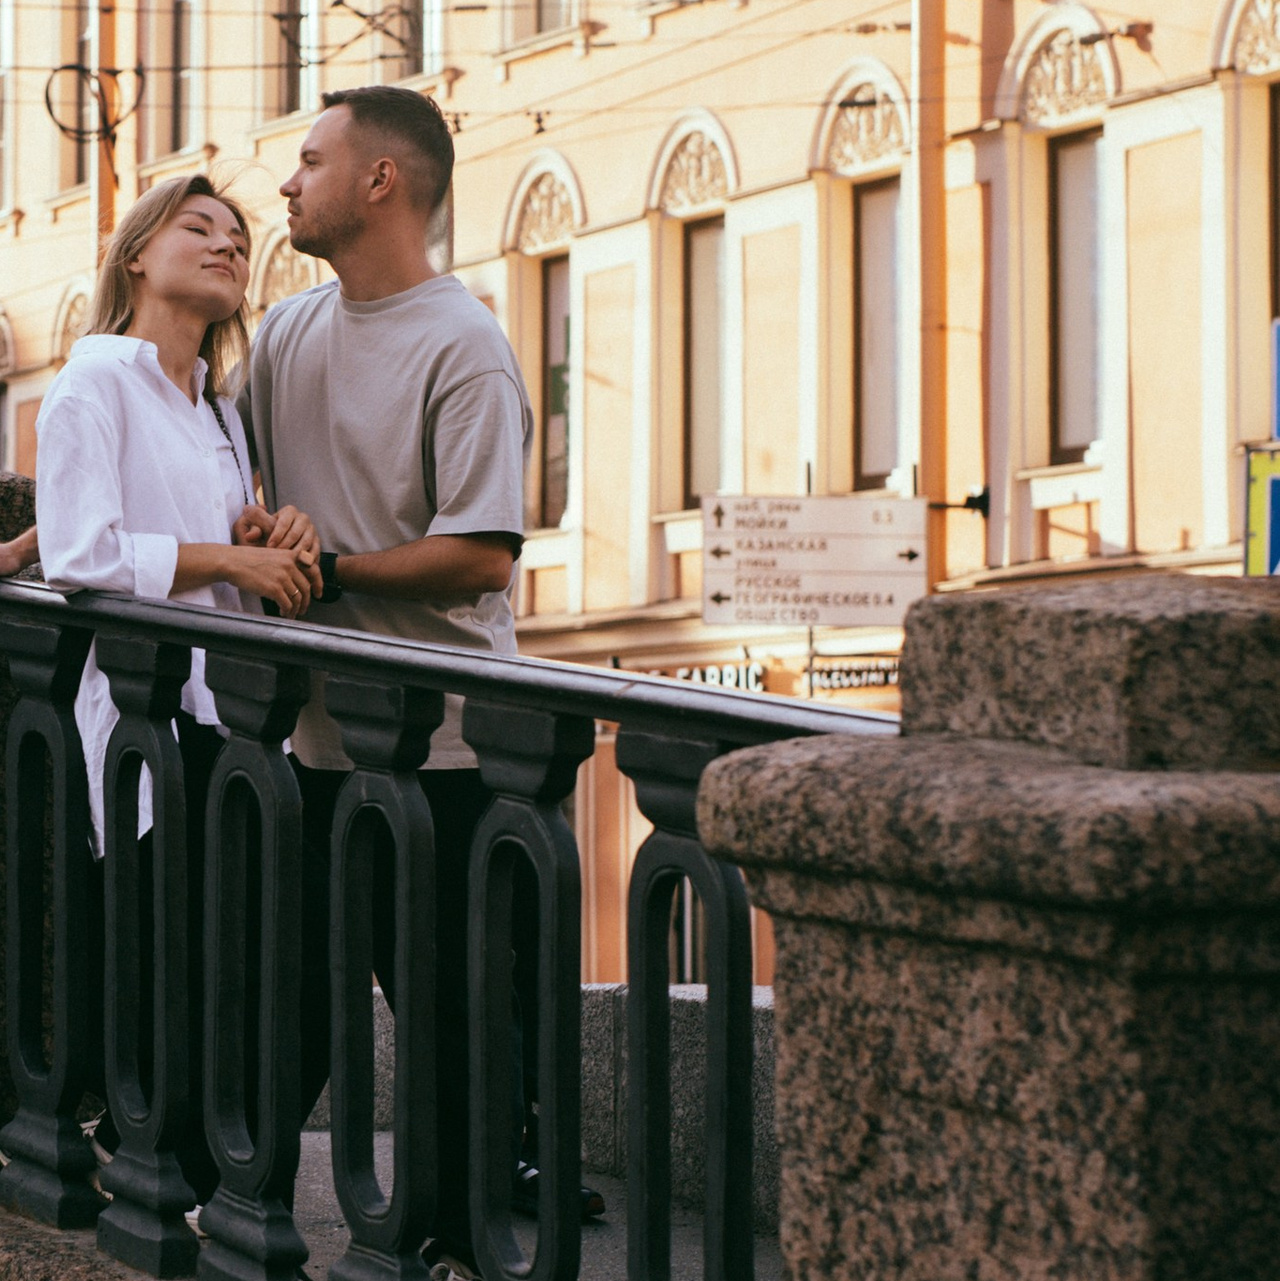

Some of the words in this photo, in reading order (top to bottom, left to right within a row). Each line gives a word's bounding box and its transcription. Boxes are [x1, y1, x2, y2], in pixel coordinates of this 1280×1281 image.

[735, 516, 788, 530] МОЙКИ
[735, 538, 828, 552] КАЗАНСКАЯ
[735, 557, 777, 570] улица
[734, 575, 801, 588] РУССКОЕ
[734, 591, 869, 606] ГЕОГРАФИЧЕСКОЕ
[735, 608, 820, 622] ОБЩЕСТВО
